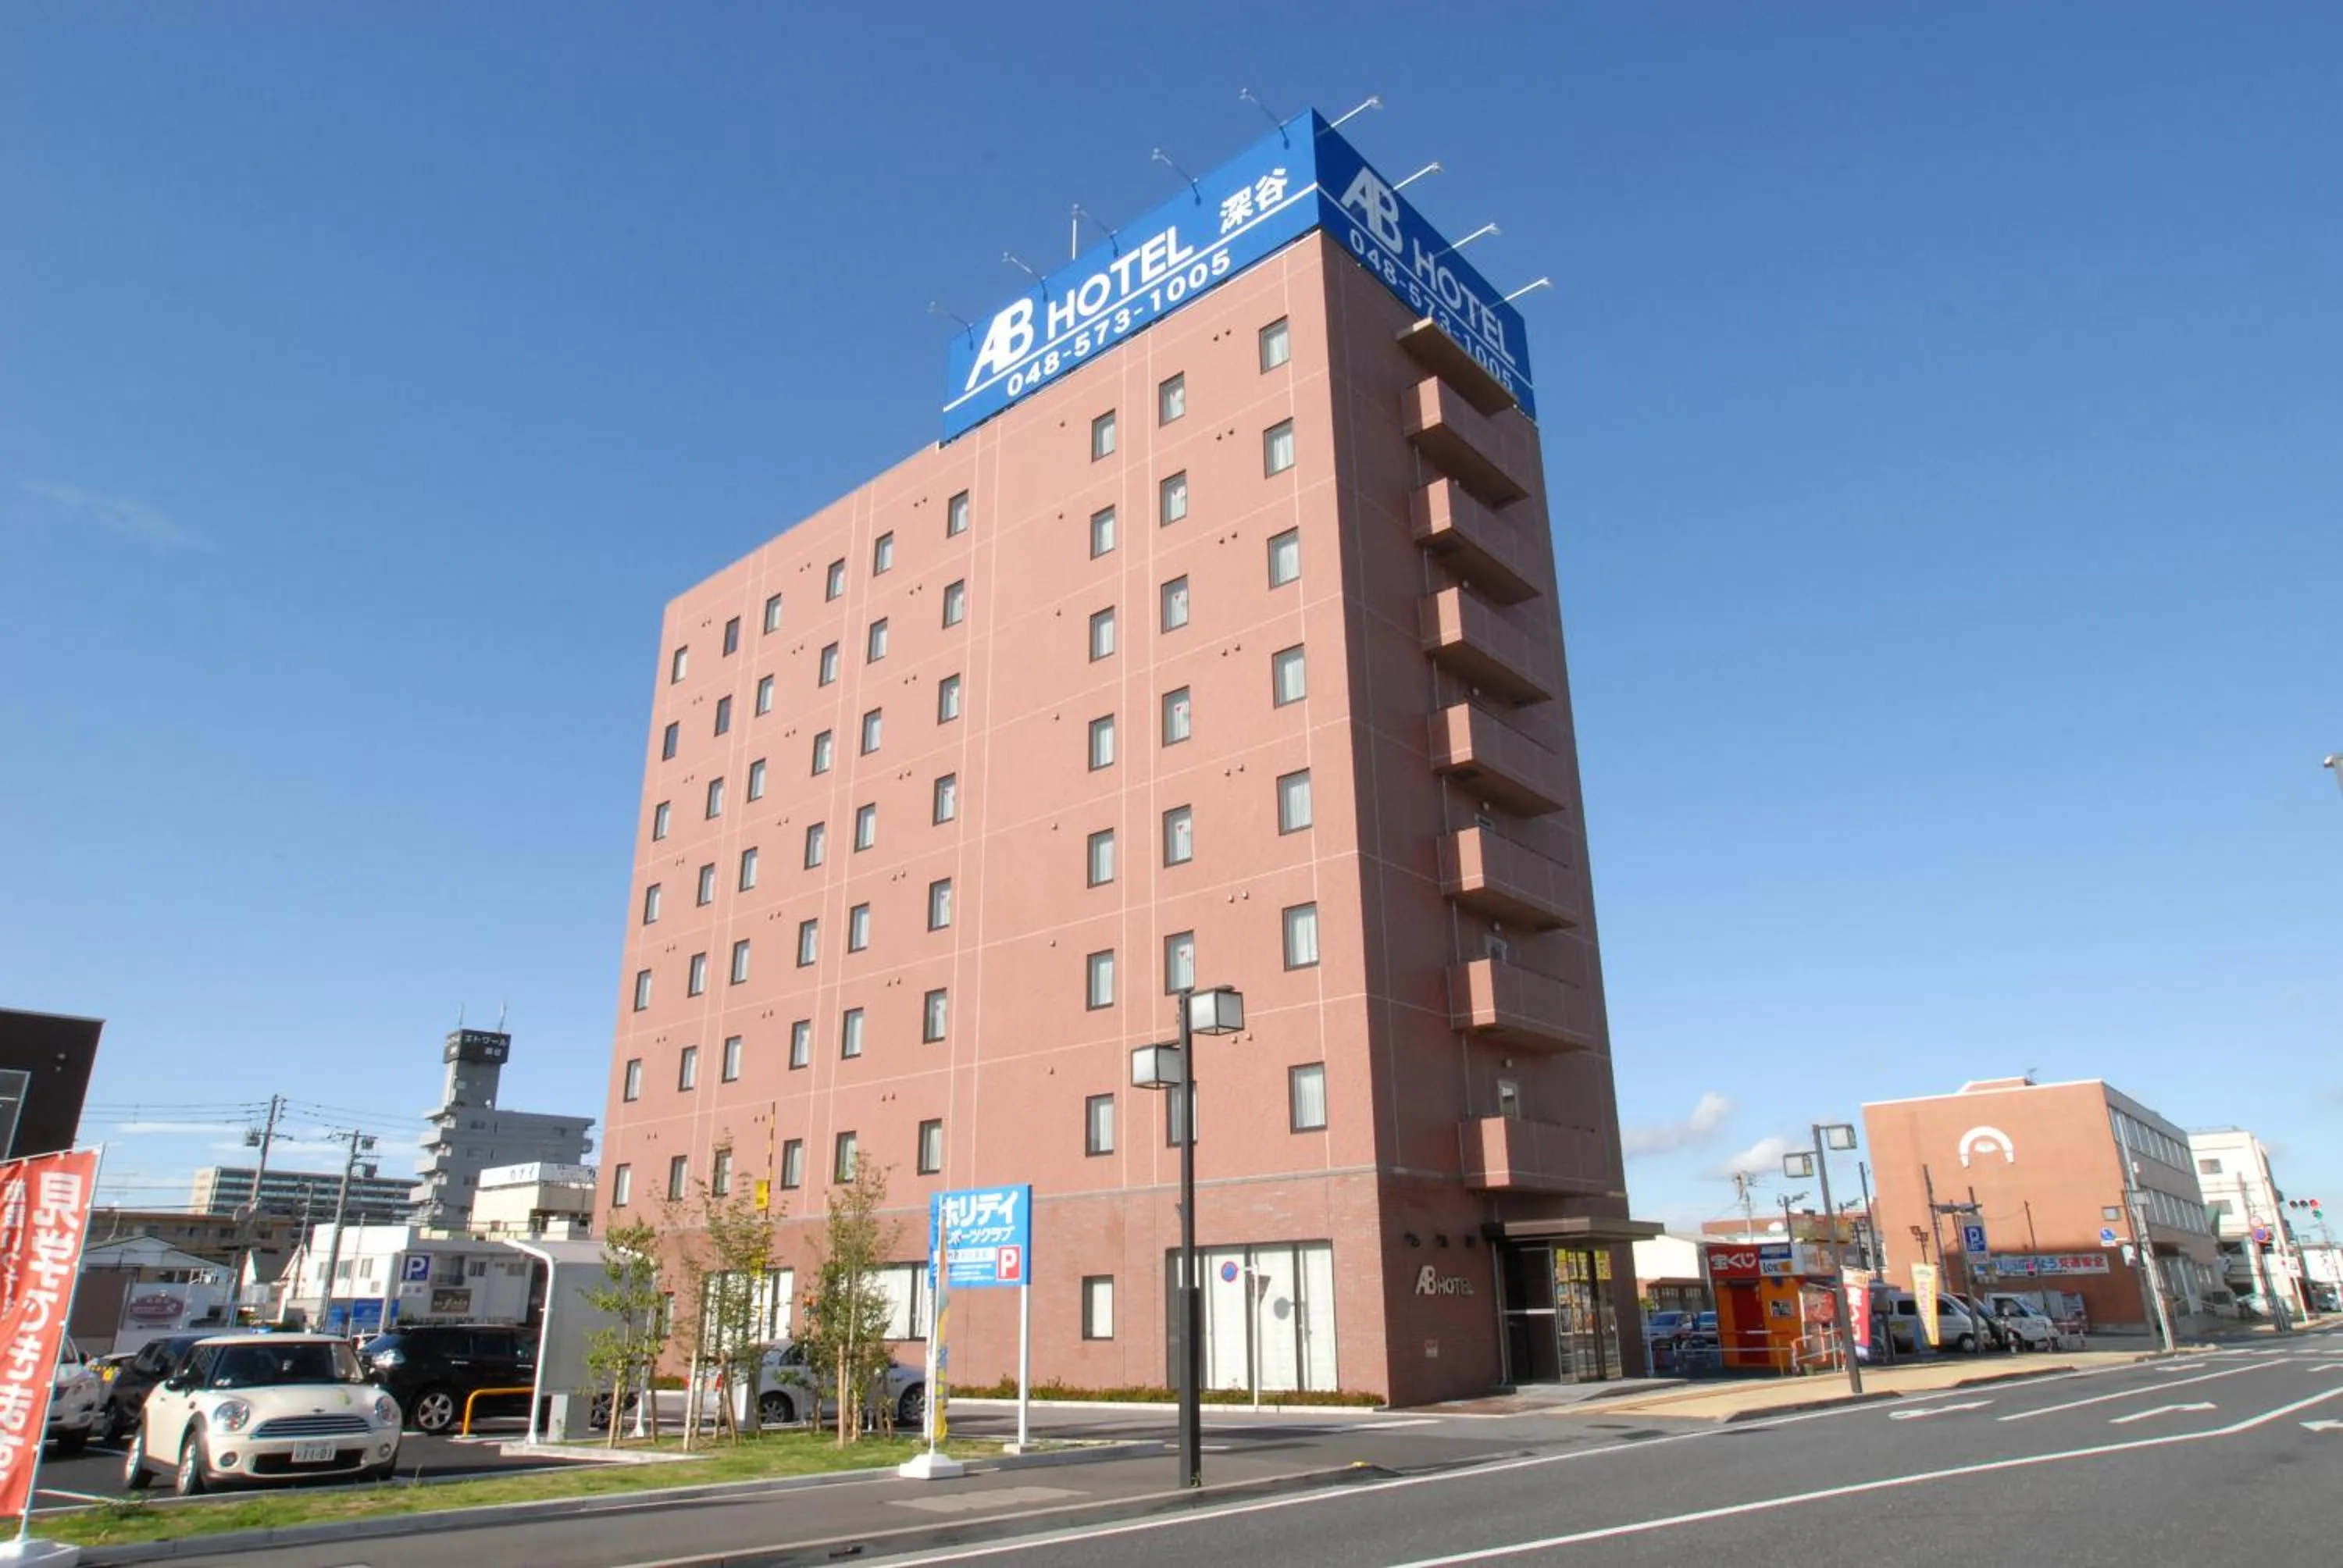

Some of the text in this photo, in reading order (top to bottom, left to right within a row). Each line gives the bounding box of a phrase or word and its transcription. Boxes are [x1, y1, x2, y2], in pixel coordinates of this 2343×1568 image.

[965, 168, 1289, 391] AB HOTEL 深谷
[1340, 166, 1516, 367] AB HOTEL
[1006, 248, 1231, 397] 048-573-1005
[947, 1225, 1015, 1245] ポーツクラブ
[405, 1256, 426, 1279] P
[1000, 1249, 1017, 1278] P
[1710, 1252, 1756, 1271] 宝くじ
[1415, 1264, 1475, 1295] AB HOTEL
